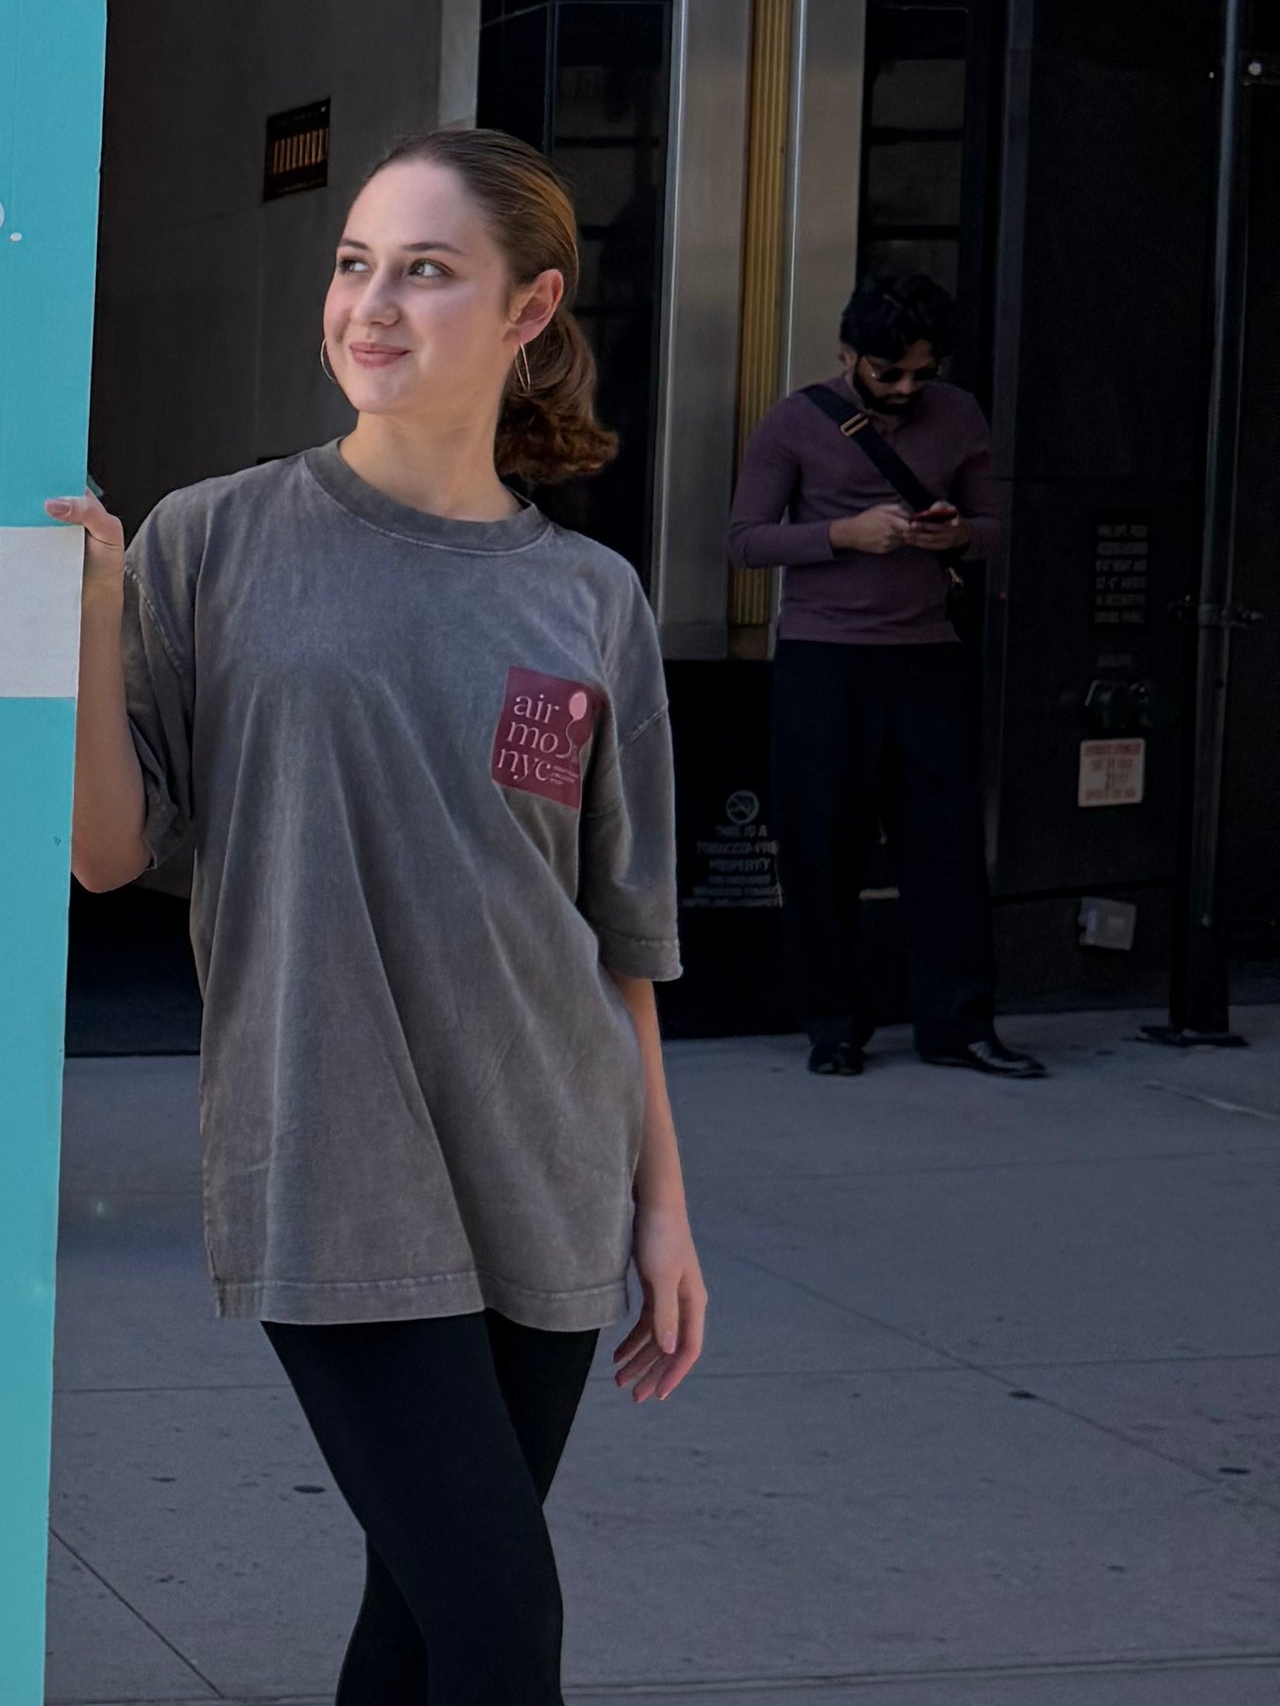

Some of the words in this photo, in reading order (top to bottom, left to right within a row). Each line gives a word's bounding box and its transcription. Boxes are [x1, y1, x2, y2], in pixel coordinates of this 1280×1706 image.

[513, 694, 560, 724] air
[506, 721, 559, 754] mo
[496, 748, 551, 782] nyc
